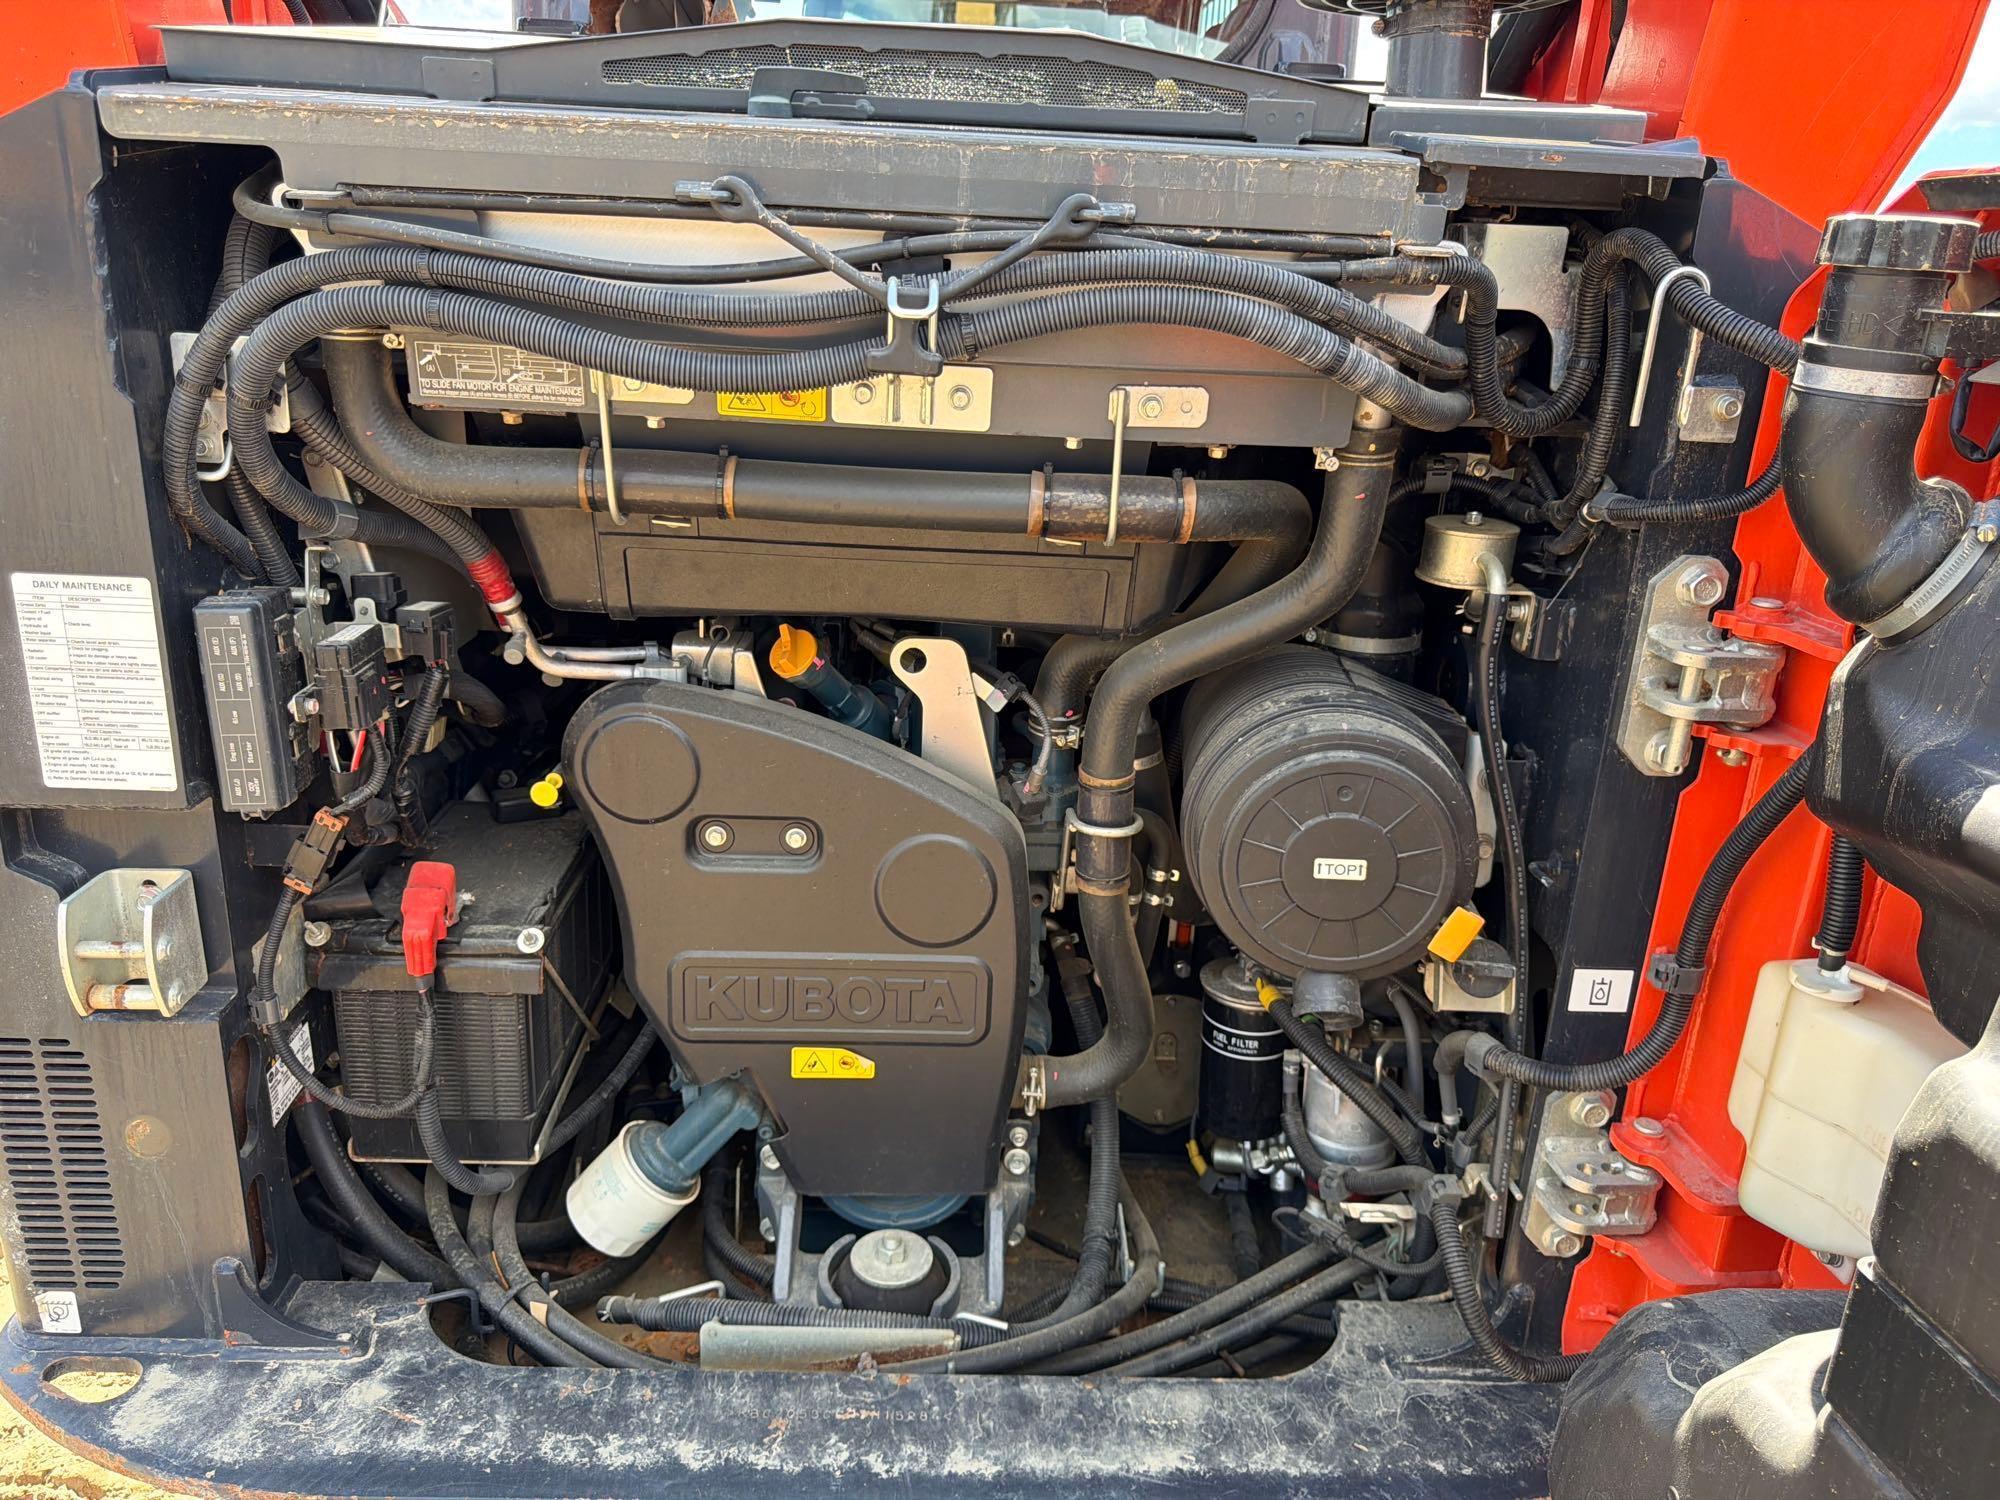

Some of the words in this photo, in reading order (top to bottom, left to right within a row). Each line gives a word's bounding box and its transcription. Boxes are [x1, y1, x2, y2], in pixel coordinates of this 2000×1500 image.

[421, 380, 430, 388] TO
[432, 380, 451, 389] SLIDE
[452, 381, 466, 390] FAN
[466, 382, 491, 391] MOTOR
[493, 382, 507, 392] FOR
[508, 384, 534, 394] ENGINE
[535, 386, 582, 396] MAINTENANCE
[32, 580, 59, 589] DAILY
[62, 581, 133, 592] MAINTENANCE
[246, 742, 254, 764] Starter
[1325, 864, 1357, 876] TOP
[695, 975, 963, 1024] KUBOTA
[1212, 1030, 1228, 1044] FUEL
[1231, 1037, 1259, 1049] FILTER
